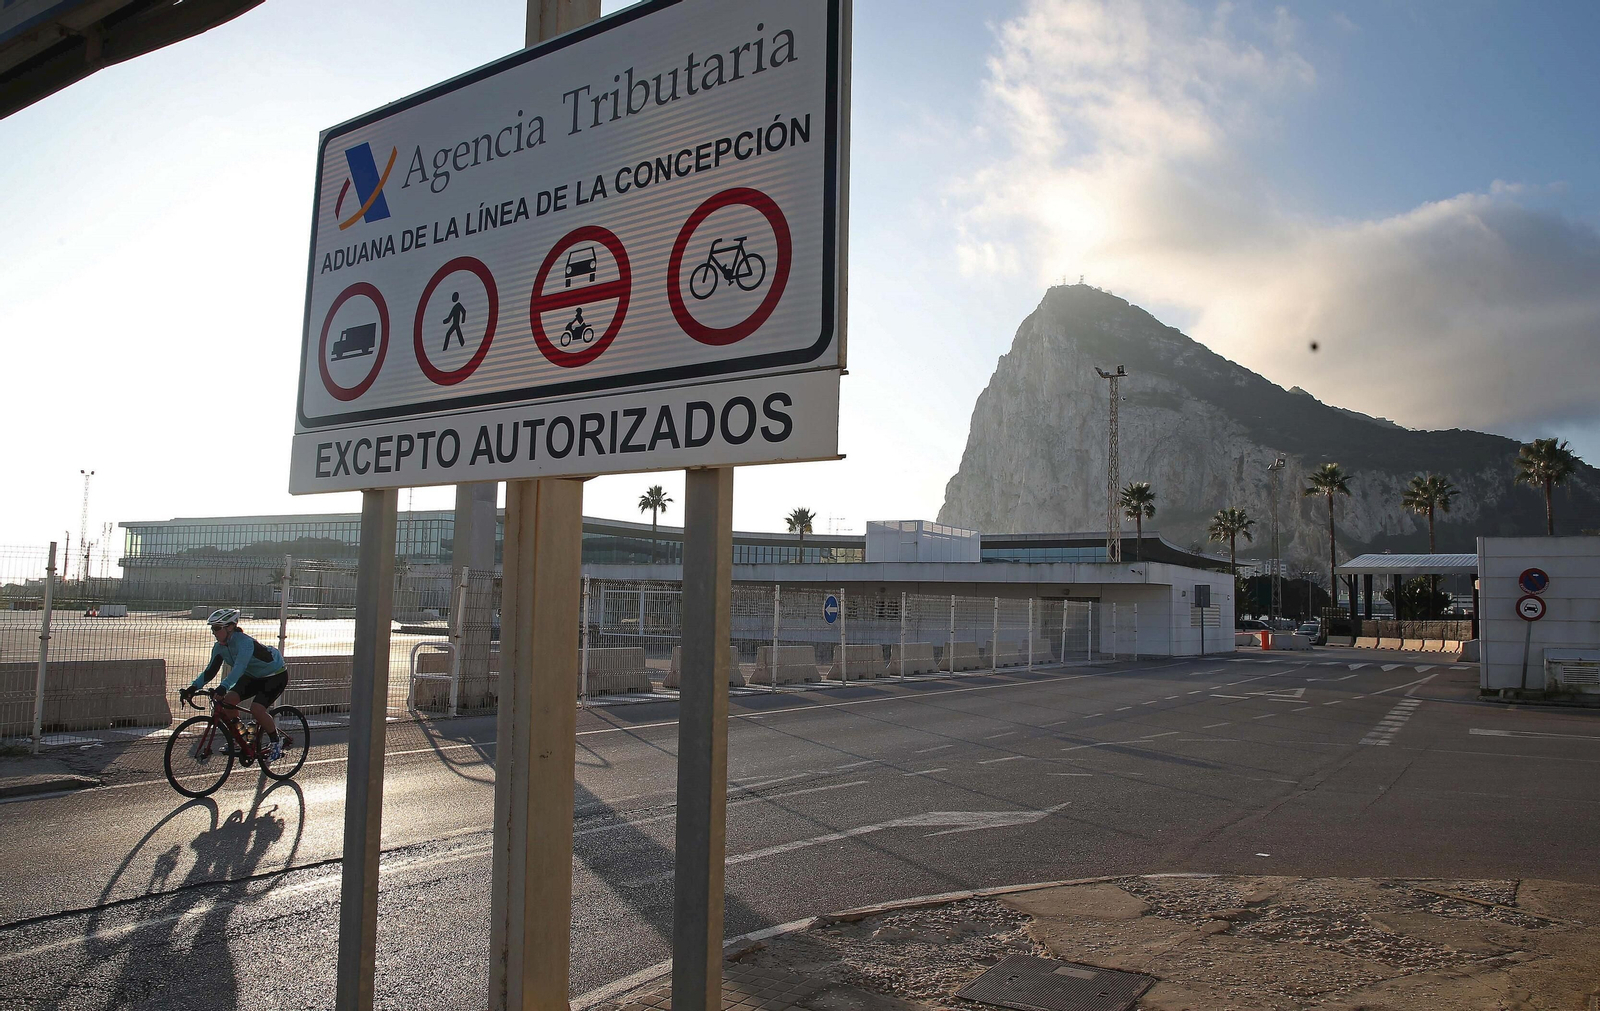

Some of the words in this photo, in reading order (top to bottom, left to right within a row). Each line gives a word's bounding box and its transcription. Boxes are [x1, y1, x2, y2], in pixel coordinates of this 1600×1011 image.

[402, 110, 547, 193] Agencia
[562, 23, 799, 135] Tributaria
[321, 235, 396, 274] ADUANA
[401, 224, 428, 252] DE
[434, 216, 460, 244] LA
[466, 197, 530, 236] LÍNEA
[537, 185, 568, 216] DE
[576, 175, 608, 206] LA
[615, 114, 811, 193] CONCEPCIÓN
[316, 429, 461, 478] EXCEPTO
[469, 392, 793, 466] AUTORIZADOS
